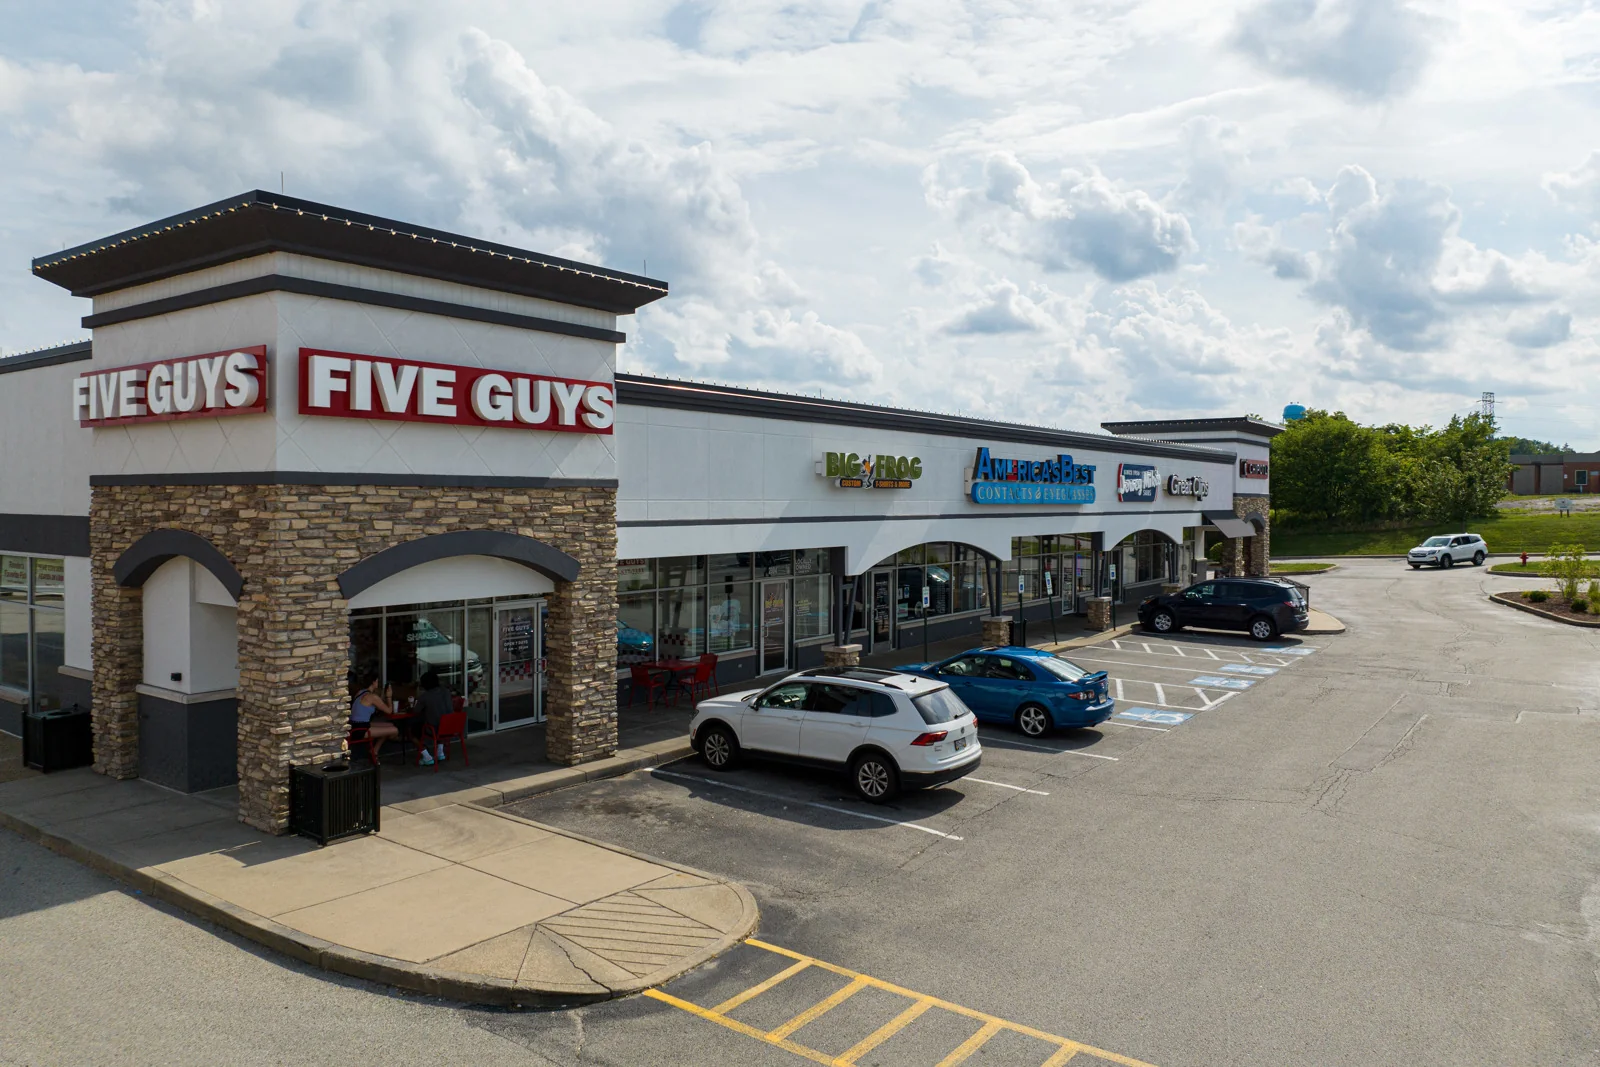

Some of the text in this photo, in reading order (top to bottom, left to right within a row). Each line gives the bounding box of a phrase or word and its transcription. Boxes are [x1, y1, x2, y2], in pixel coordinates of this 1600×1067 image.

[73, 352, 259, 421] FIVE GUYS
[308, 354, 613, 429] FIVE GUYS
[824, 452, 922, 479] BIG FROG
[1058, 454, 1096, 484] BEST
[841, 479, 862, 487] CUSTOM
[978, 486, 1095, 500] CONTACTS & EYEGLASSES
[1170, 474, 1193, 495] Great
[406, 631, 438, 642] SHAKES
